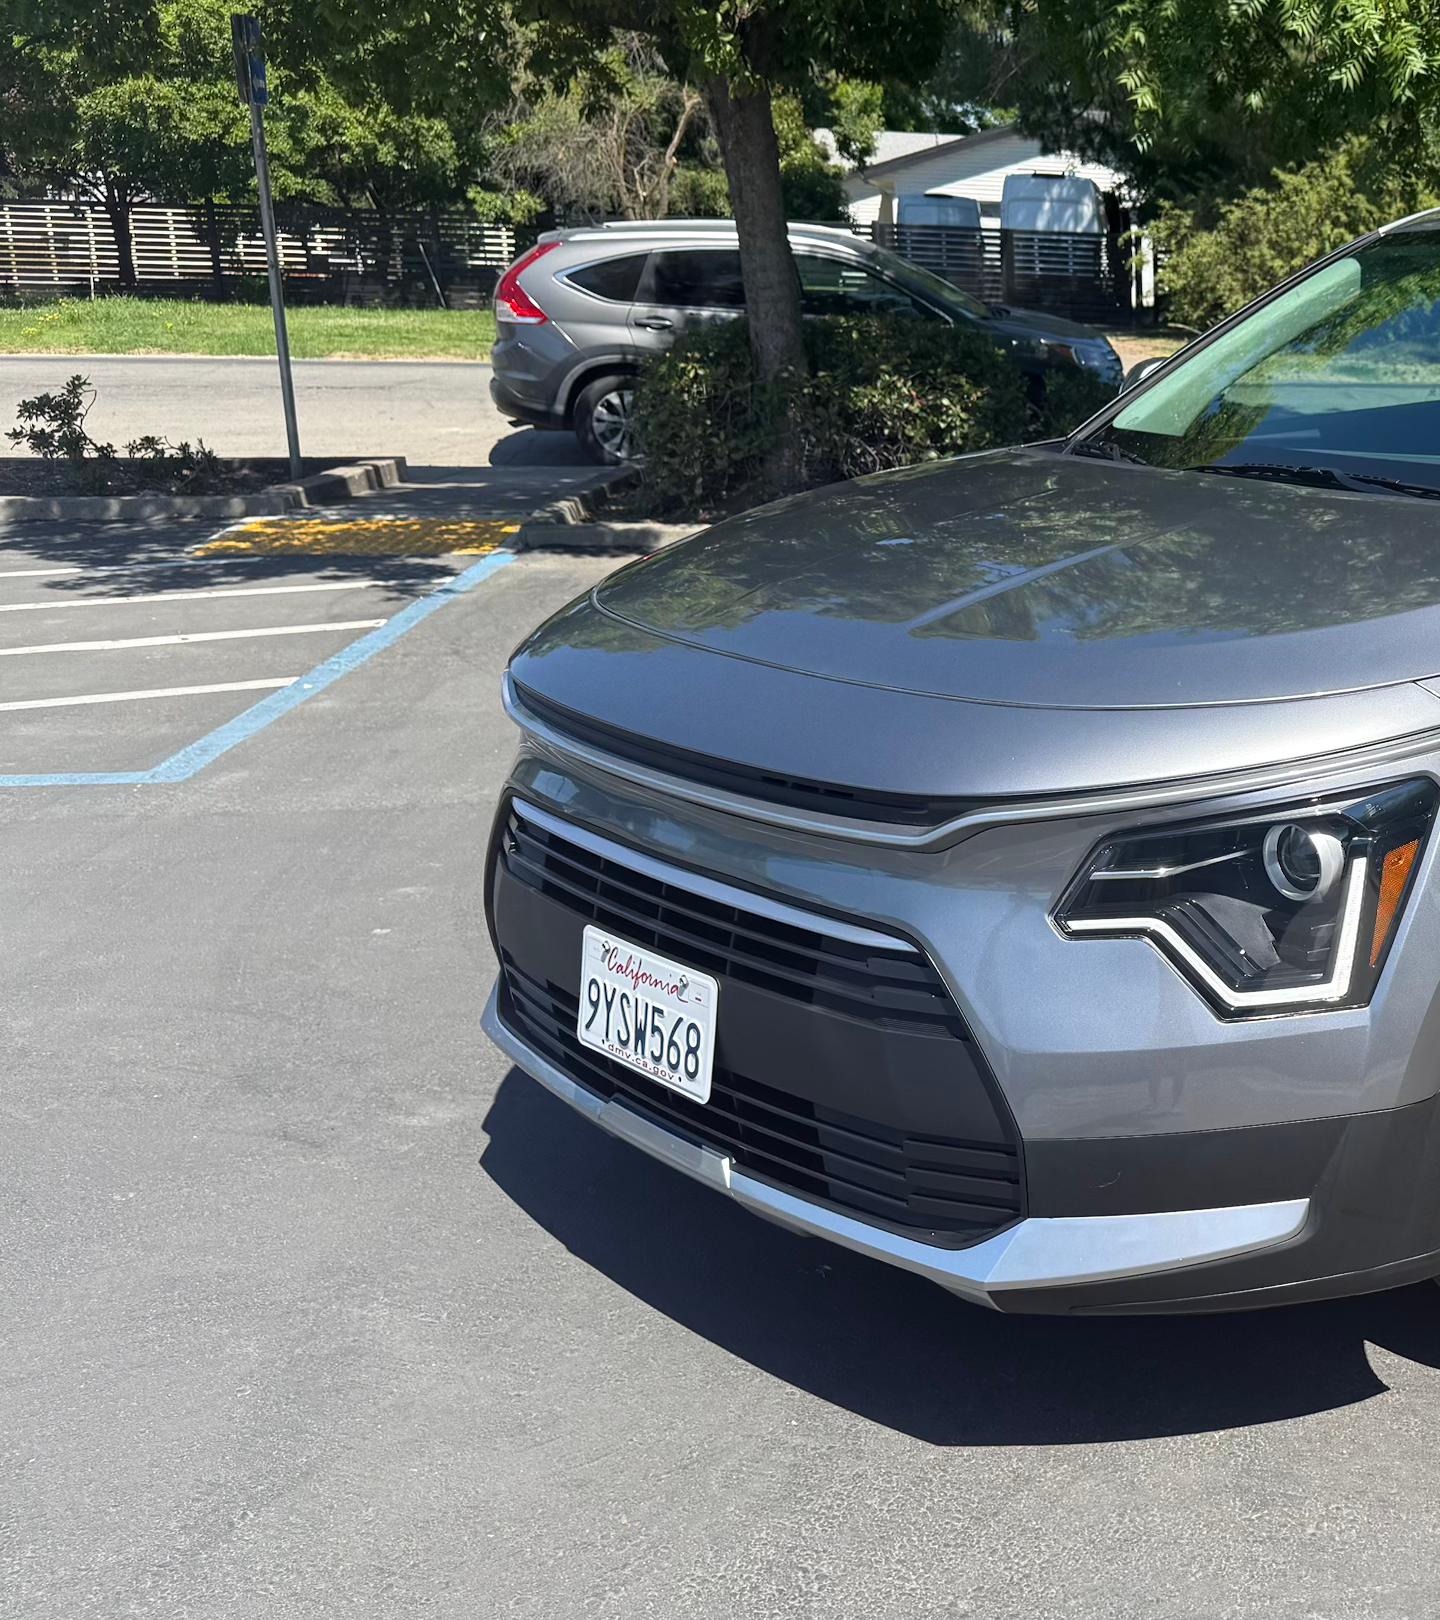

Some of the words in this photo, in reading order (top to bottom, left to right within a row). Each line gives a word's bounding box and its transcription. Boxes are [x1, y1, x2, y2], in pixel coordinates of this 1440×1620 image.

[607, 946, 688, 1003] California
[585, 978, 701, 1080] 9YSW568
[608, 1043, 675, 1080] dmv.ca.gov
